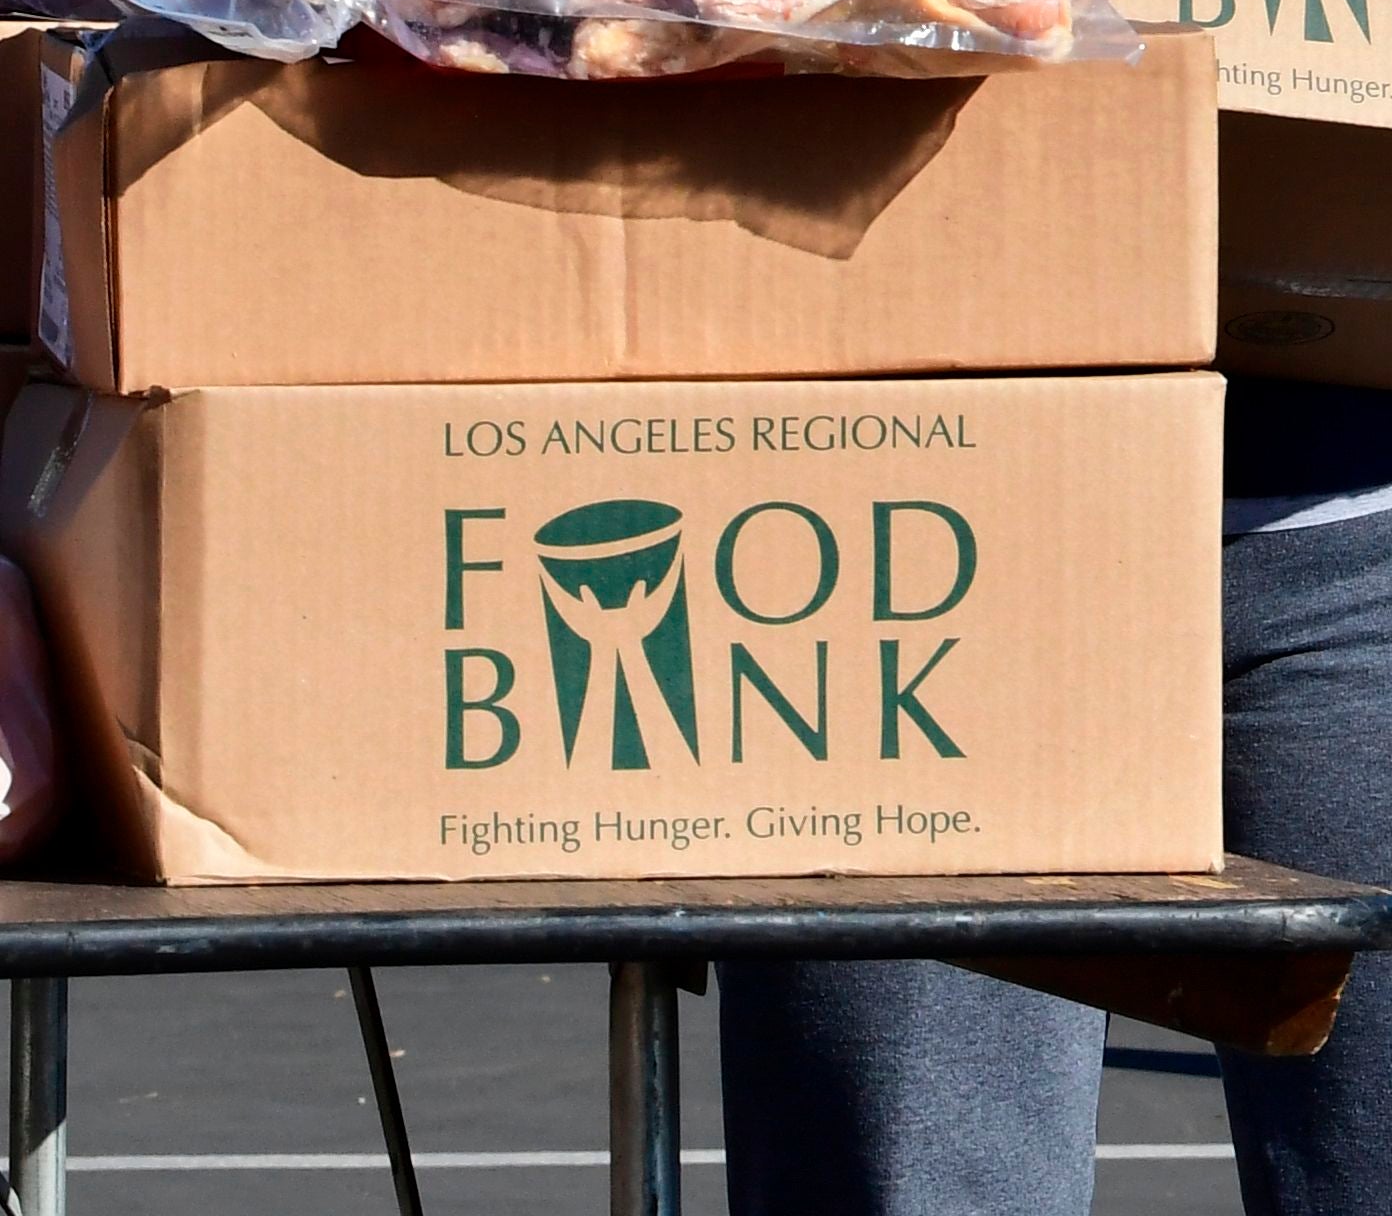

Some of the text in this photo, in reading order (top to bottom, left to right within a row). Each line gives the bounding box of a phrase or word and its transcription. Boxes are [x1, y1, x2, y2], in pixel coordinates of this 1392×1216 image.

[1217, 58, 1282, 96] hting
[445, 414, 977, 457] LOS ANGELES REGIONAL
[440, 804, 981, 856] Fighting Hunger. Giving Hope.
